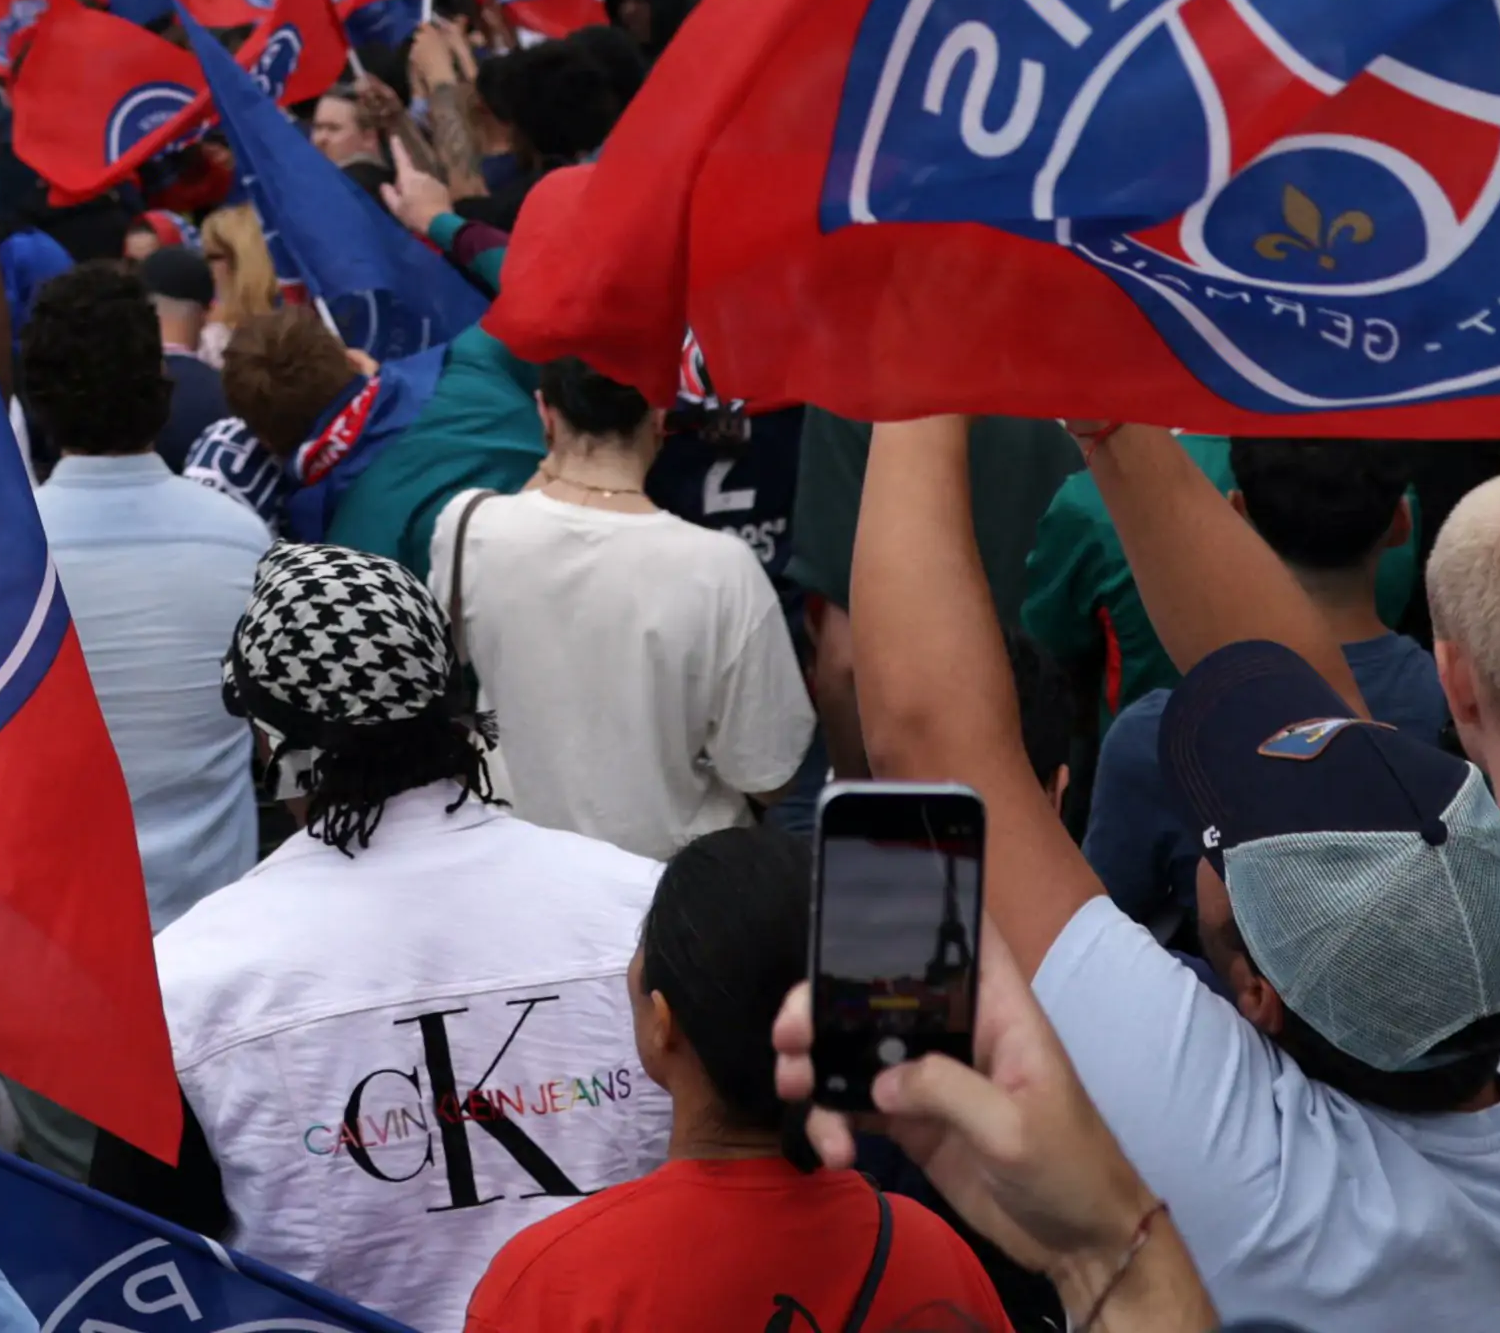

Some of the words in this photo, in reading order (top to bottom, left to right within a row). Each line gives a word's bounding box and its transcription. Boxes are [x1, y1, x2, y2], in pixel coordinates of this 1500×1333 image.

[304, 1102, 429, 1156] CALVIN
[436, 1085, 525, 1124] KLEIN
[531, 1068, 633, 1117] JEANS
[344, 994, 608, 1214] CK
